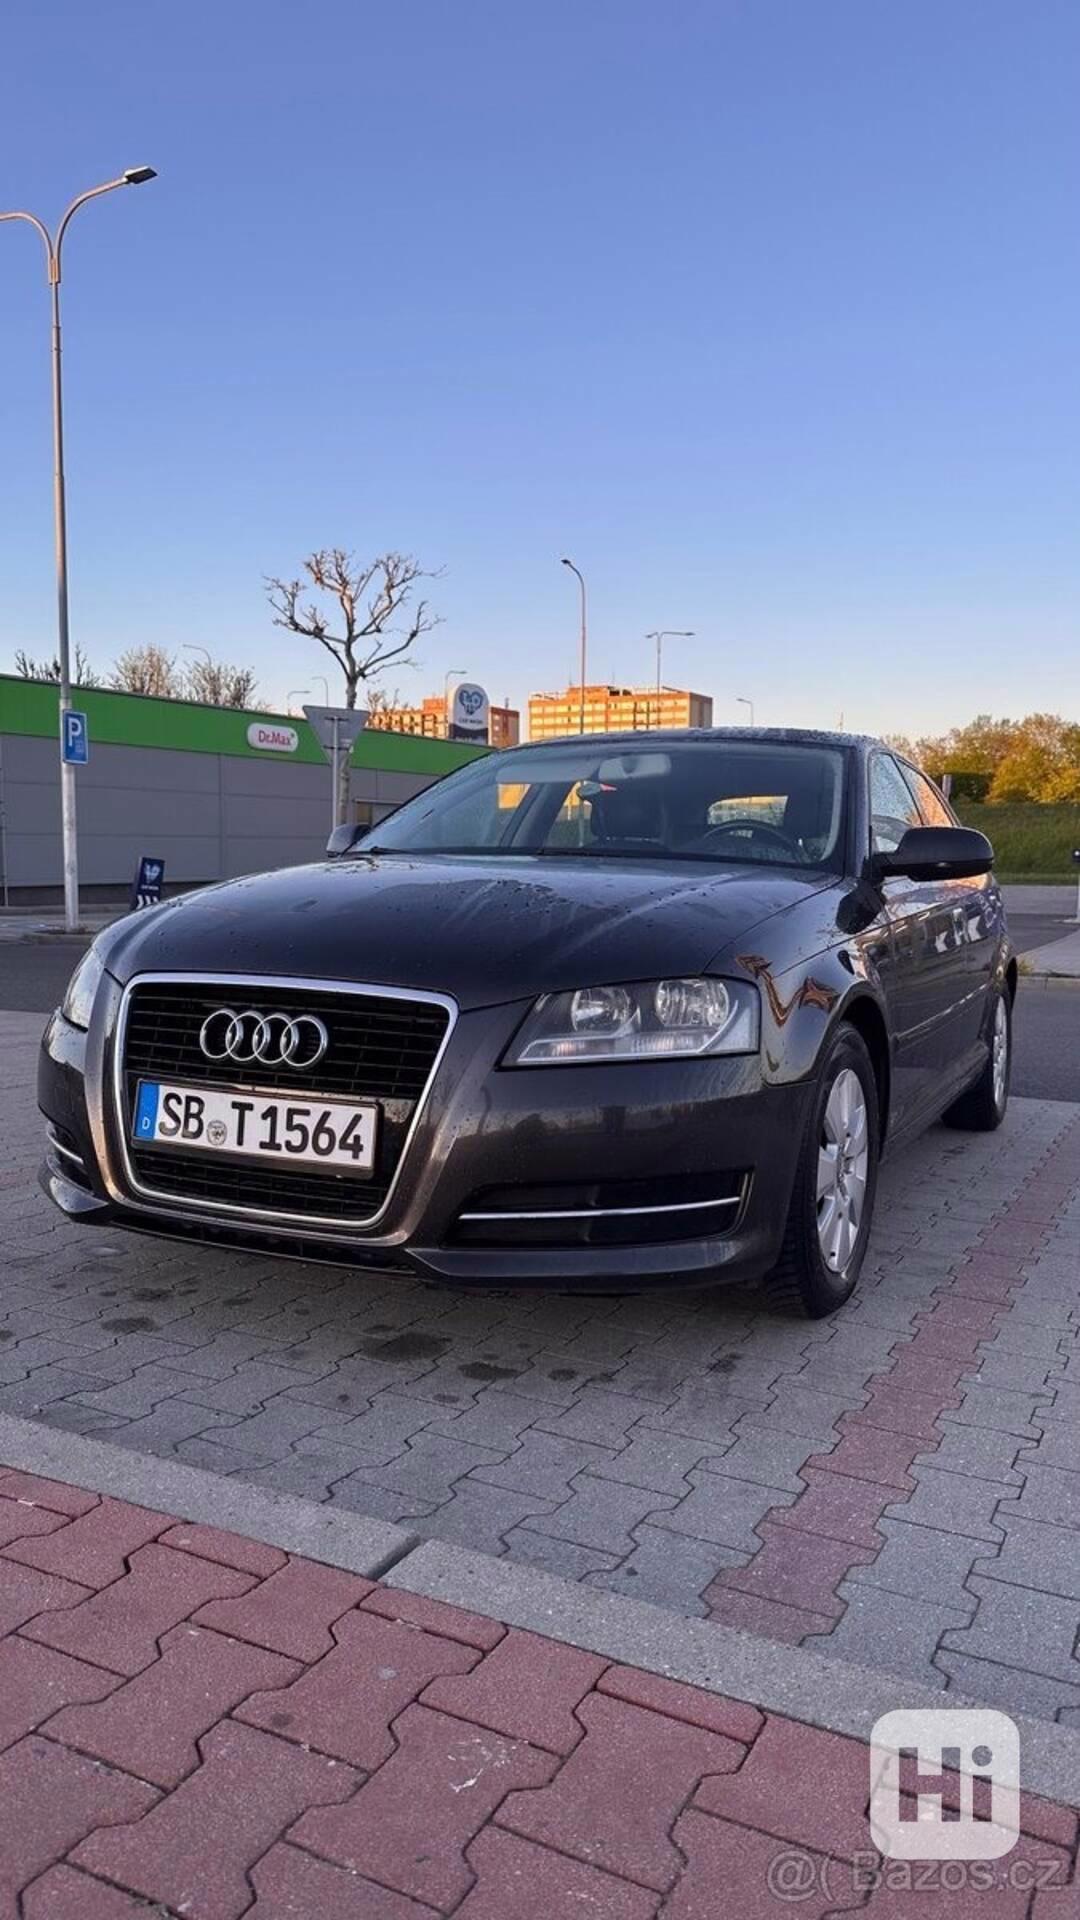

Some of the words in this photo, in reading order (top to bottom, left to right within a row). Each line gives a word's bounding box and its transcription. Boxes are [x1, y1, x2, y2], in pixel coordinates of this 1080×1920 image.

[68, 717, 82, 747] P
[142, 1117, 149, 1130] D
[158, 1092, 205, 1140] SB
